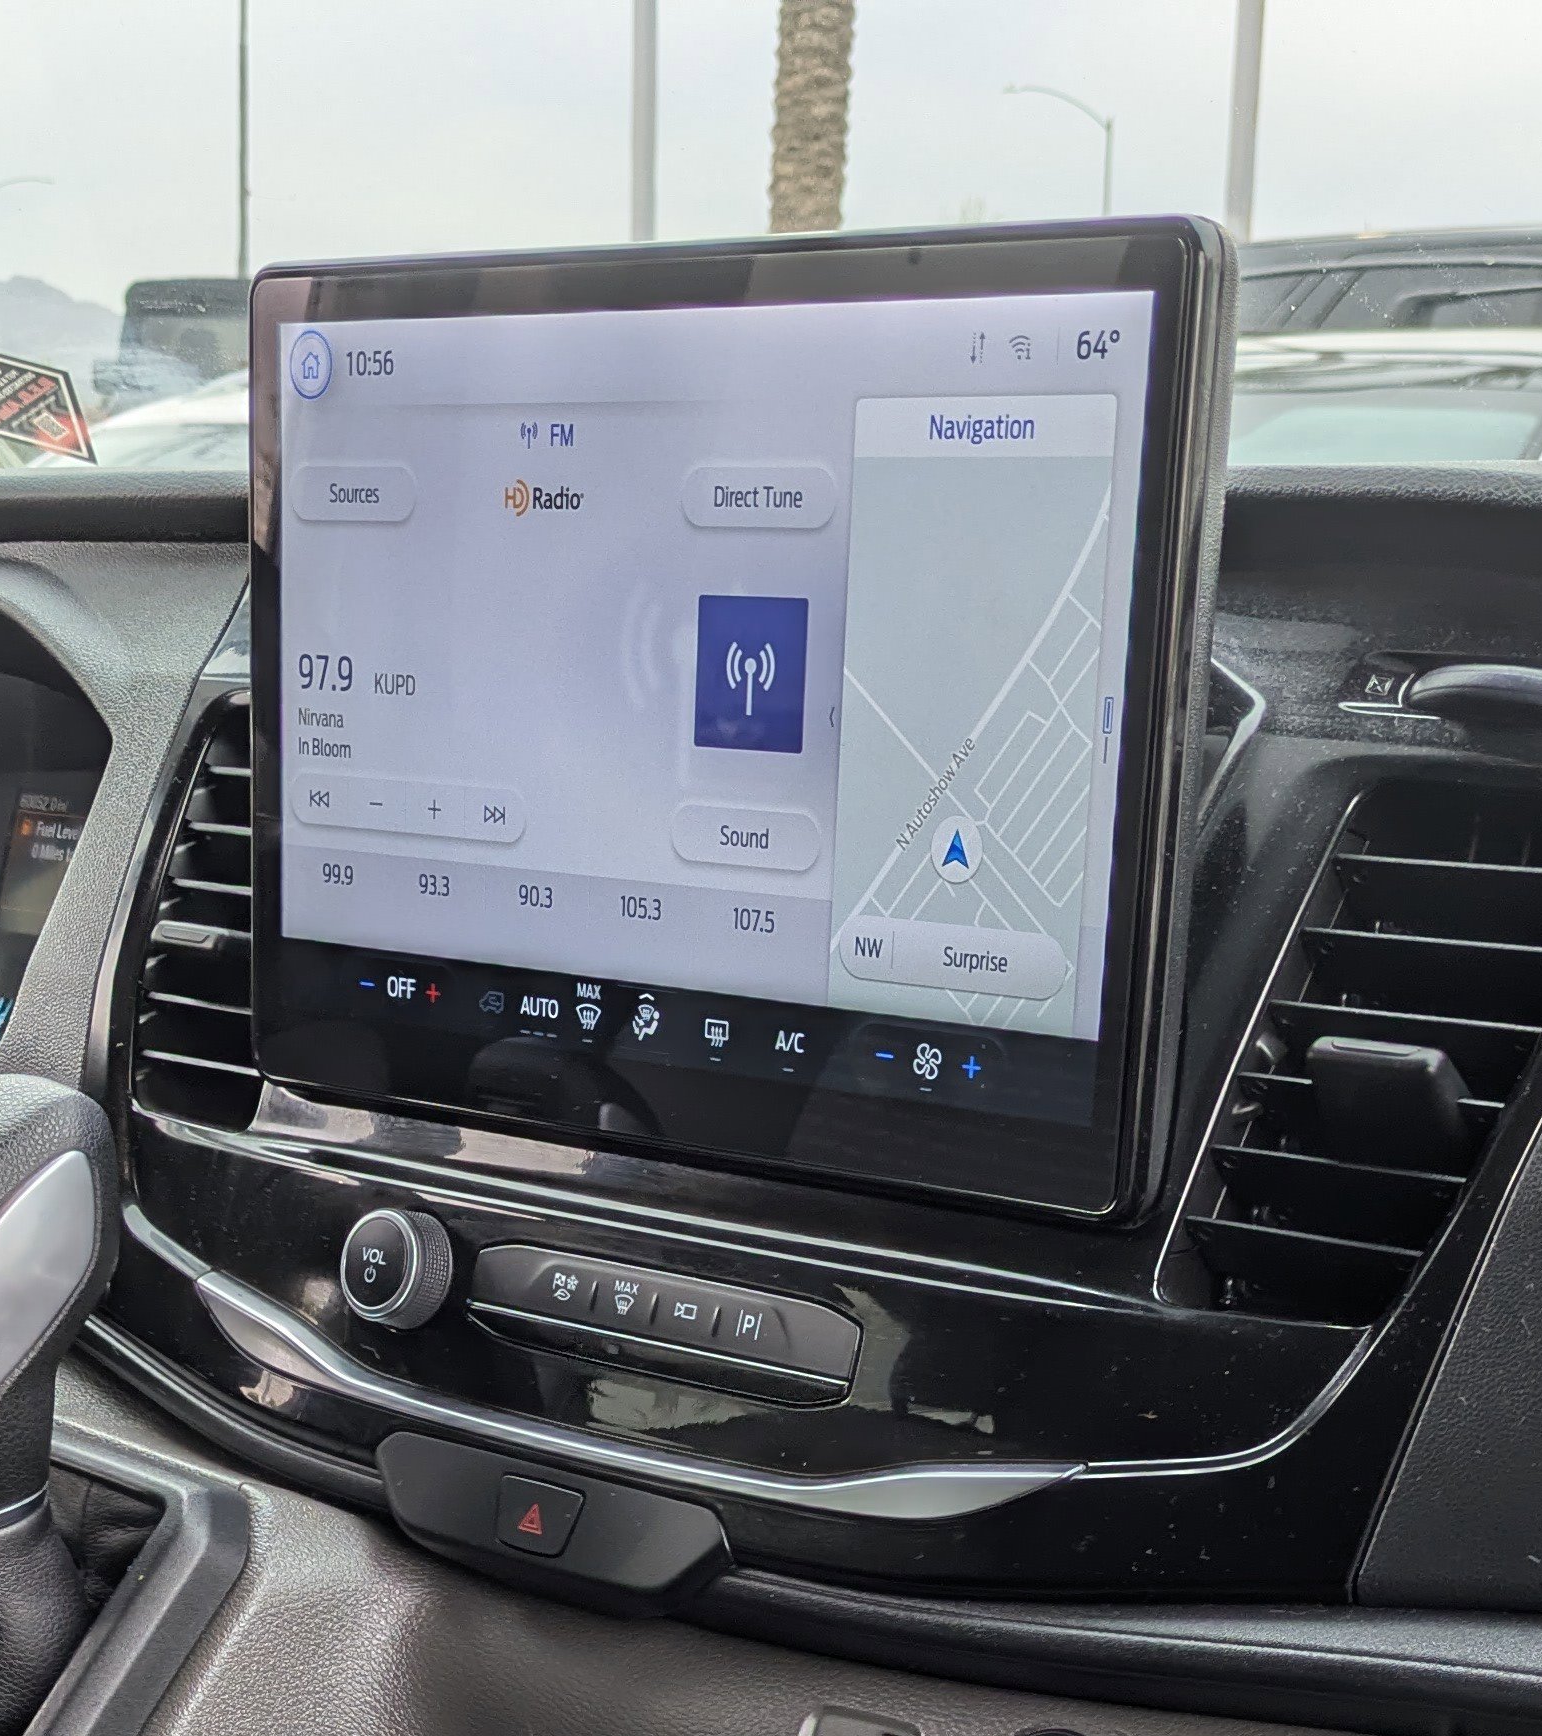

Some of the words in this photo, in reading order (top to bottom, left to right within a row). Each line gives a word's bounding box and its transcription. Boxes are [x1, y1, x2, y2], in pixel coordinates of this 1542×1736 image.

[1076, 329, 1120, 360] 64°
[345, 349, 395, 377] 10:56
[549, 423, 574, 447] FM
[929, 413, 1035, 445] Navigation
[328, 482, 380, 505] Sources
[713, 486, 760, 509] Direct
[762, 486, 803, 510] Tune
[297, 653, 353, 692] 97.9
[374, 673, 416, 696] KUPD
[297, 708, 344, 729] Nirvana
[297, 737, 309, 754] In
[312, 739, 351, 759] Bloom
[895, 836, 908, 851] N
[905, 767, 957, 840] Autoshow
[951, 737, 976, 769] Ave
[719, 826, 770, 850] Sound
[322, 863, 354, 886] 99.9
[418, 874, 450, 897] 93.3
[519, 884, 553, 909] 90.3
[620, 895, 662, 921] 105.3
[733, 906, 775, 934] 107.5
[854, 937, 883, 958] NW
[943, 947, 1008, 975] Surprise
[387, 976, 416, 999] OFF
[576, 983, 601, 1000] MAX
[520, 996, 559, 1019] AUTO
[775, 1030, 805, 1053] A/C
[361, 1246, 387, 1266] VOL
[614, 1280, 640, 1296] MAX
